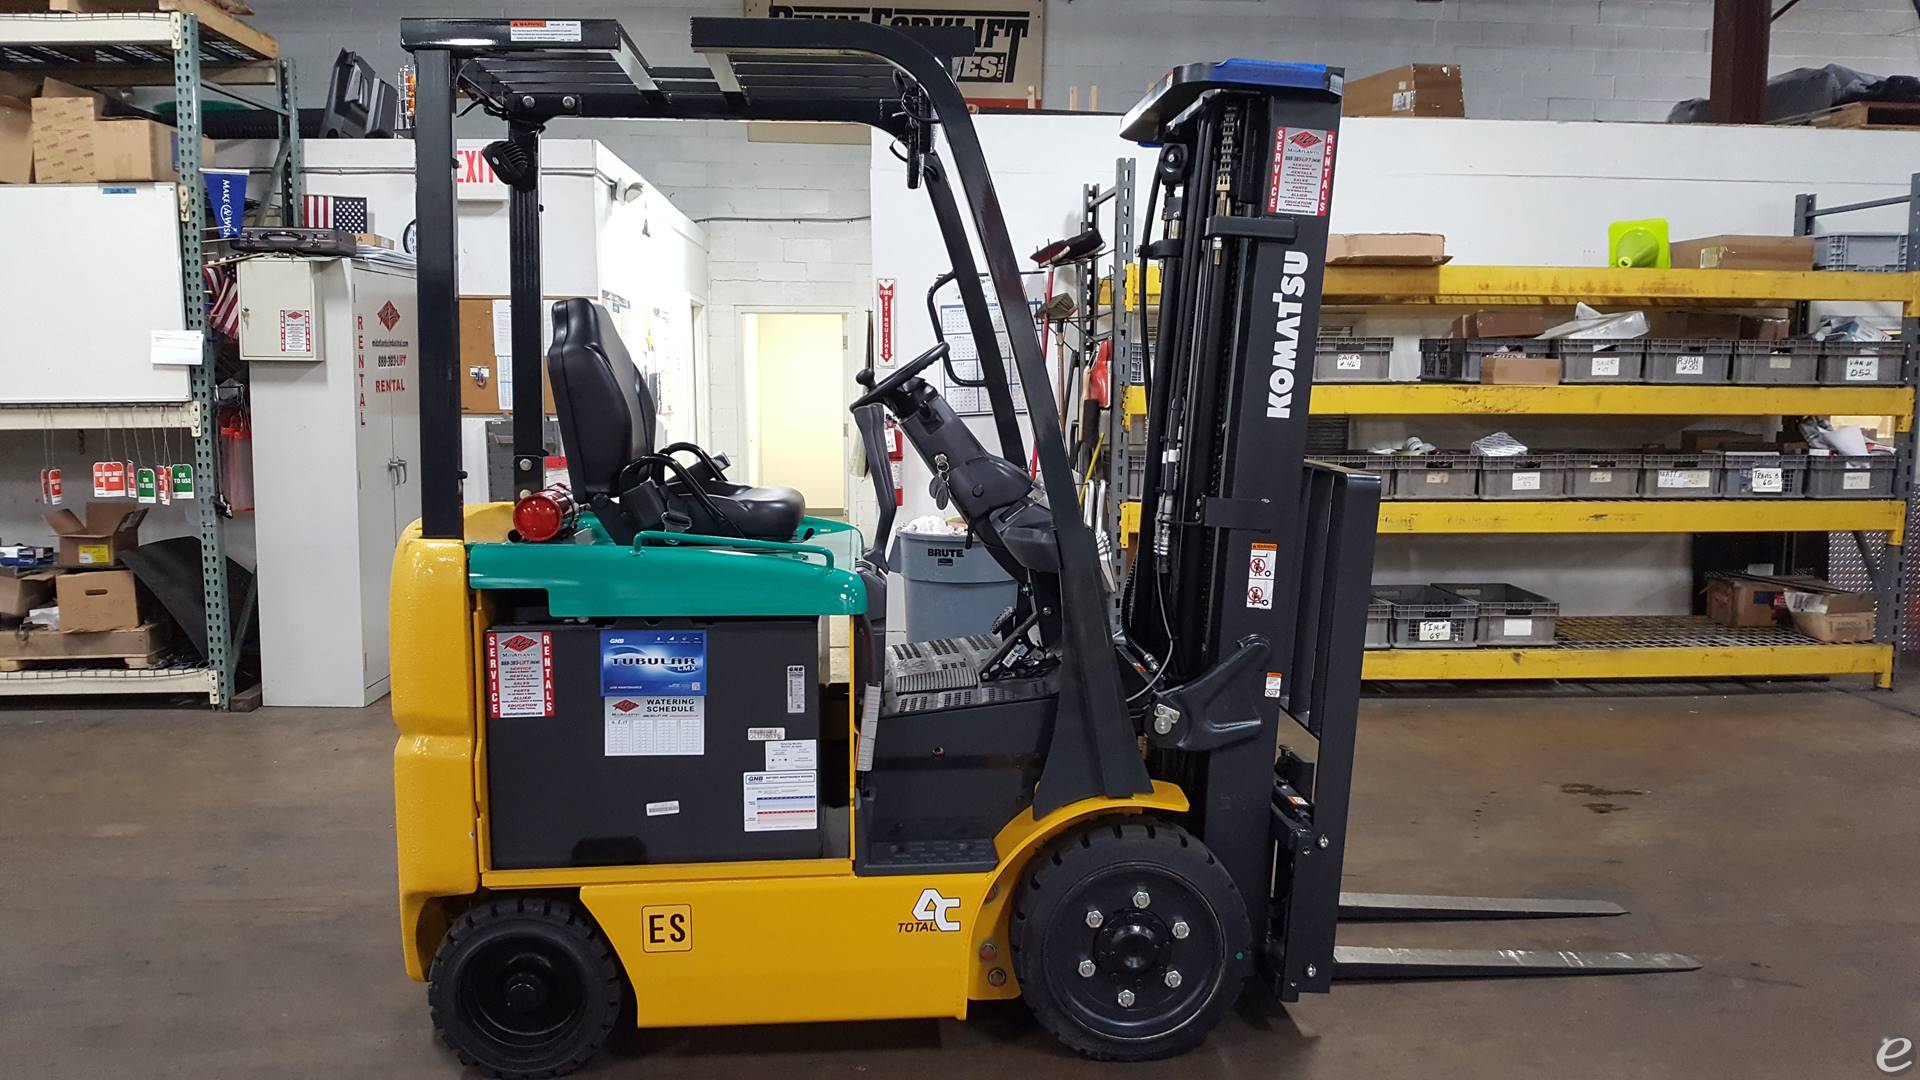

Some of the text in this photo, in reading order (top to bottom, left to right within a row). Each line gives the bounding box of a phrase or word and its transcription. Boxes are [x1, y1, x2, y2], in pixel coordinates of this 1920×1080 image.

[1270, 130, 1283, 207] SERVICE
[1319, 134, 1333, 212] RENTALS
[1267, 250, 1309, 419] KOMATSU
[357, 316, 366, 425] RENTAL
[375, 379, 405, 392] RENTAL
[928, 549, 964, 557] BRUTE
[489, 637, 498, 713] SERVICE
[543, 635, 553, 712] RENTALS
[611, 657, 696, 665] TUBULAR
[649, 913, 687, 943] ES
[897, 921, 938, 933] TOTAL
[911, 887, 961, 933] AC
